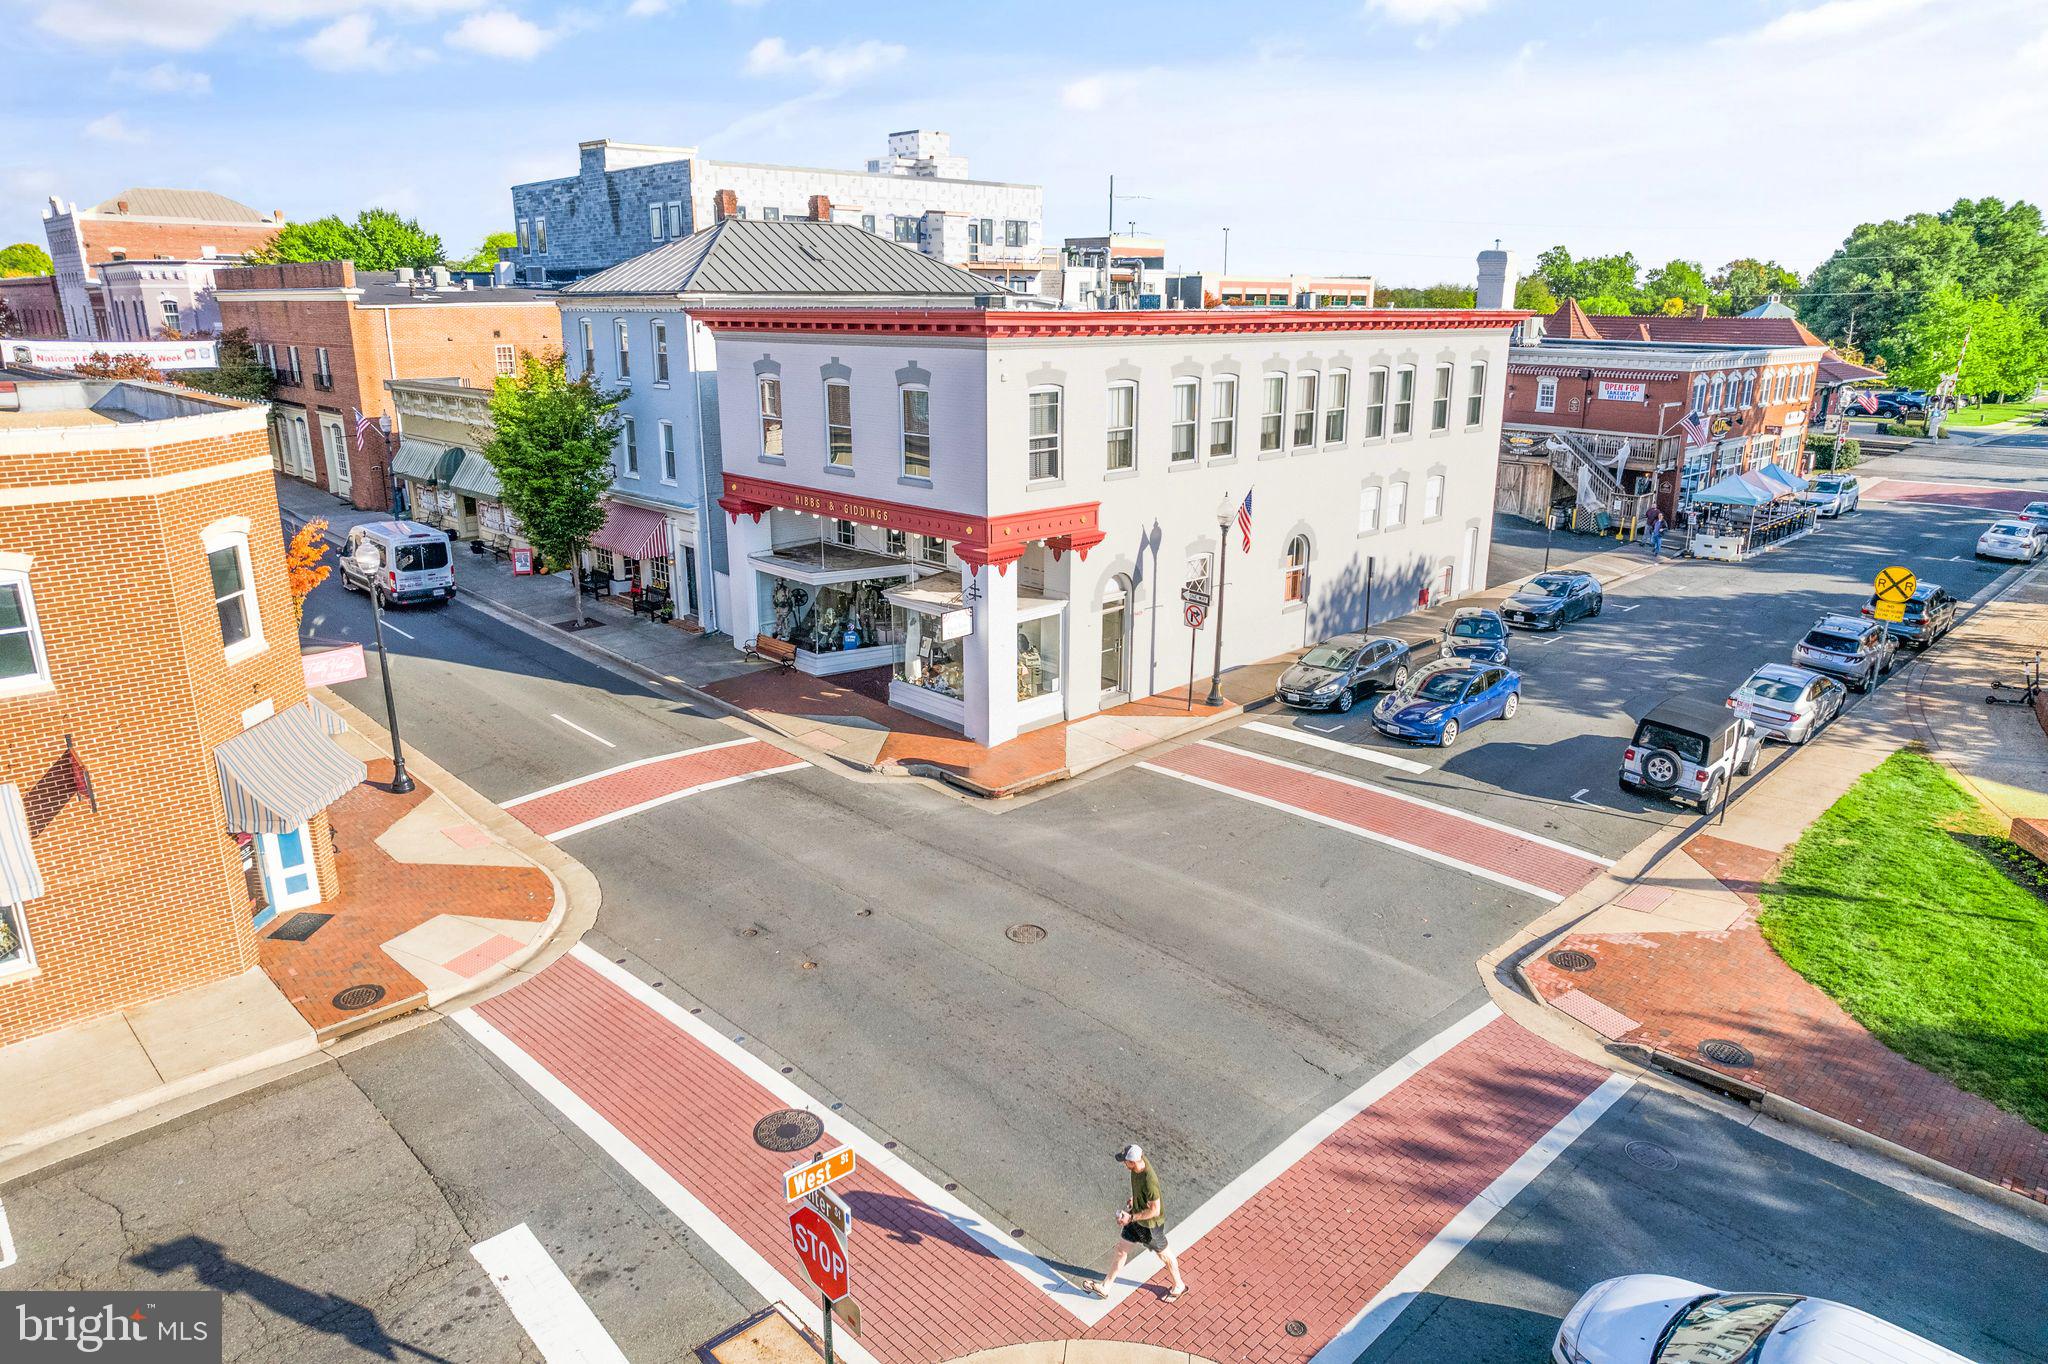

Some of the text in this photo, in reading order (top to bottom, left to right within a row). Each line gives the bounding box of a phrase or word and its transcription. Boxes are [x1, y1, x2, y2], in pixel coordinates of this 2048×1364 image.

[36, 354, 79, 363] National
[158, 354, 183, 362] Week
[1604, 383, 1623, 391] OPEN
[795, 495, 889, 521] HIBBS & GIDDINGS
[1878, 579, 1913, 591] R R
[793, 1152, 849, 1196] West St
[795, 1223, 845, 1281] STOP
